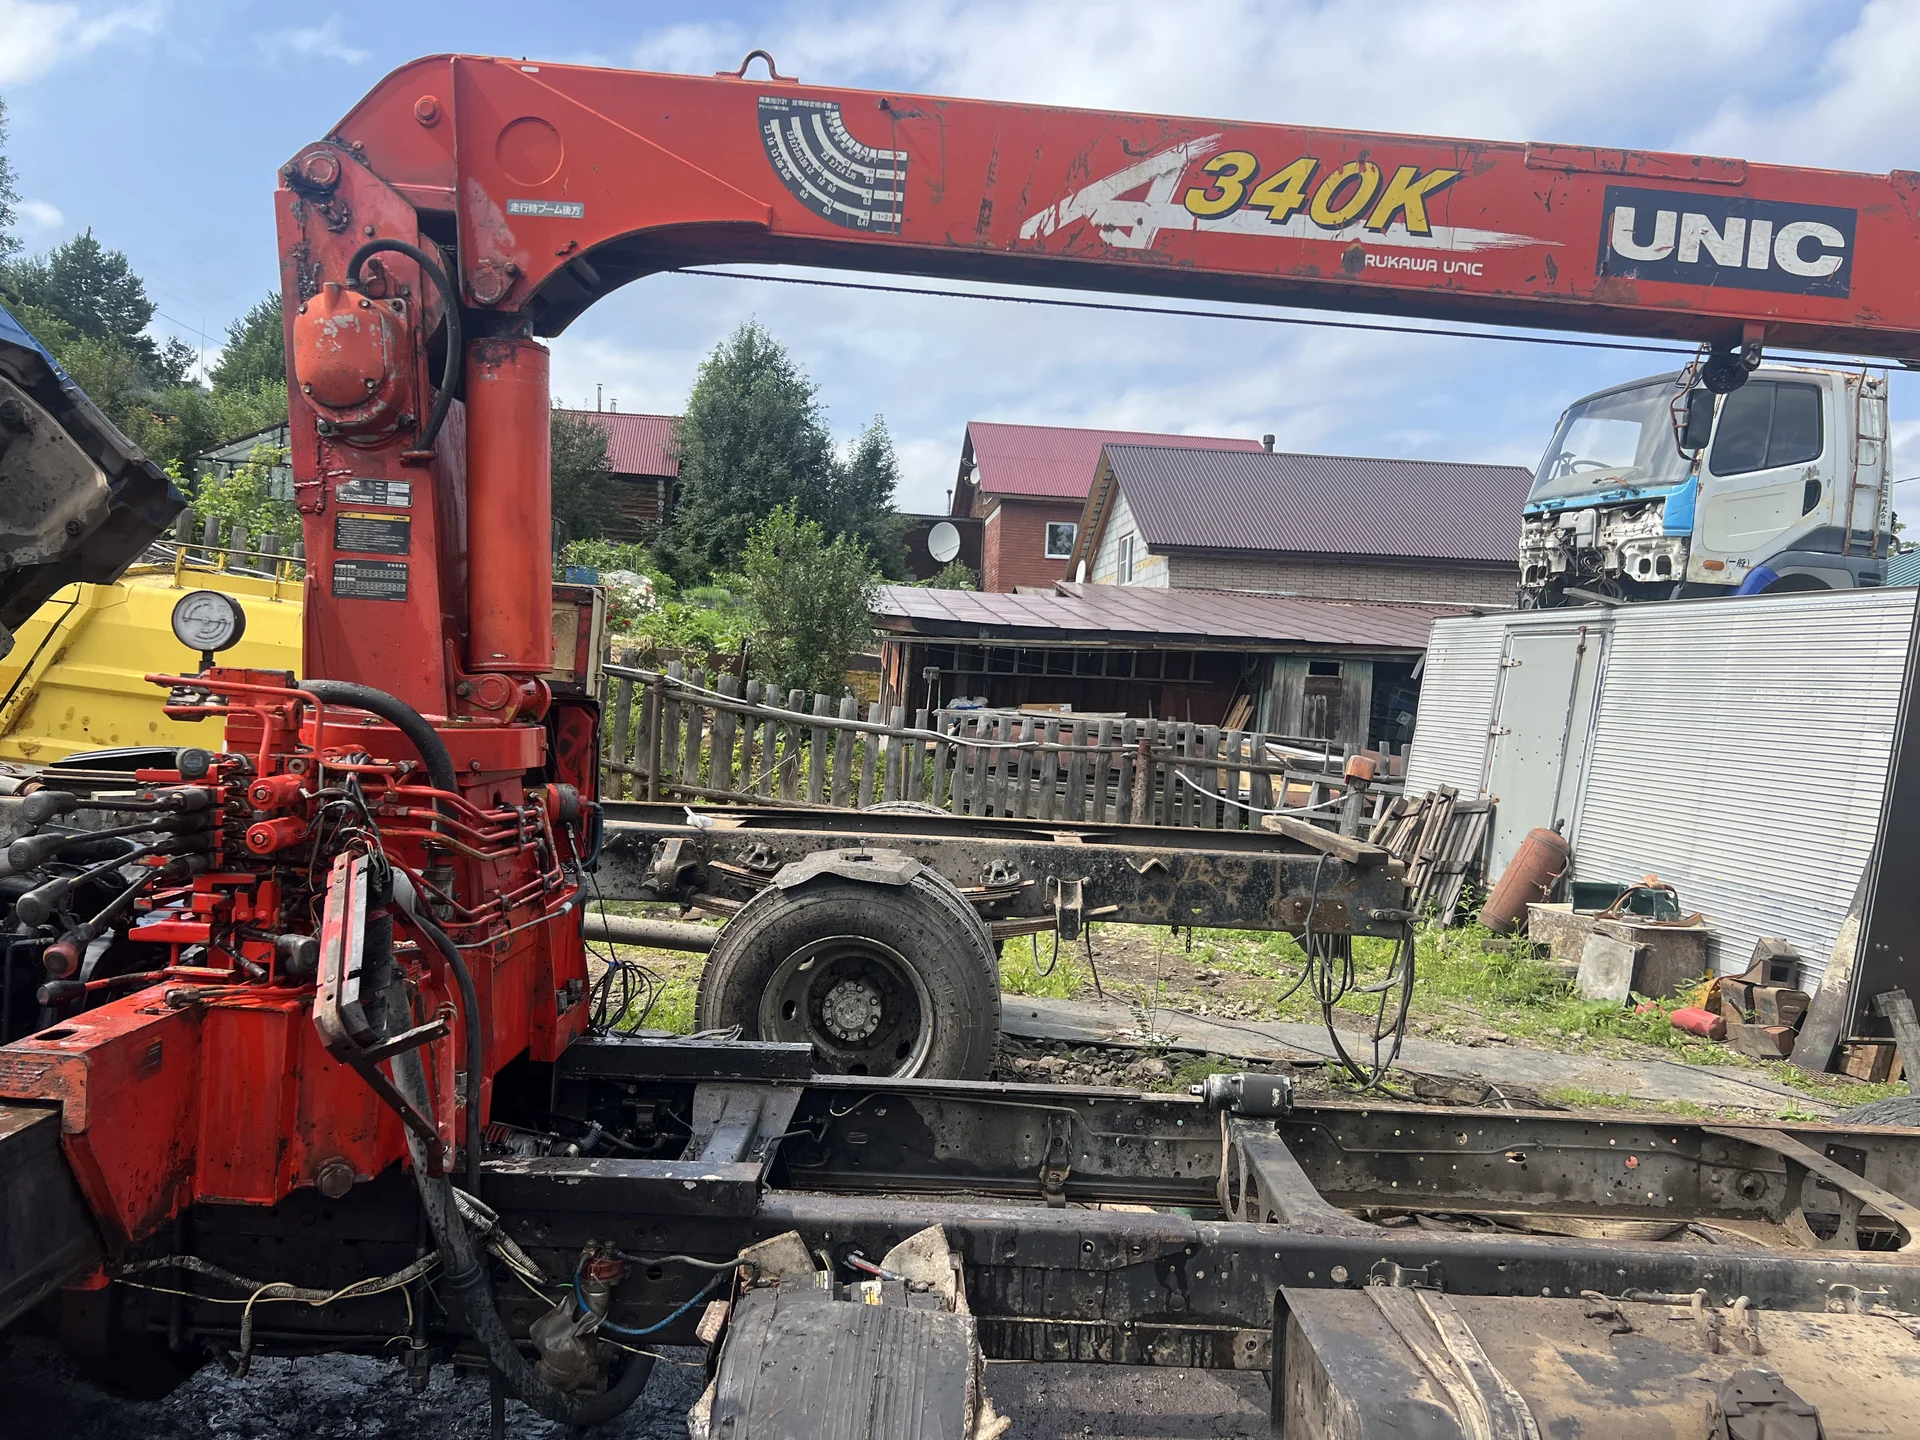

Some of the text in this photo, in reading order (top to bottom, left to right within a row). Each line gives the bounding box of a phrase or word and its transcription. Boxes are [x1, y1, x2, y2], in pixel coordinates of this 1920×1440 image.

[764, 124, 772, 134] 2.3
[766, 137, 774, 146] 1.9
[770, 149, 779, 158] 1.3
[790, 139, 798, 148] 2.7
[806, 166, 814, 175] 1.2
[828, 160, 838, 168] 2.7
[836, 166, 846, 174] 2.4
[846, 170, 857, 180] 2.15
[828, 184, 836, 194] 0.9
[1184, 150, 1469, 237] 340K
[510, 202, 581, 216] 走行時ブーム後方
[822, 206, 832, 216] 0.5
[857, 218, 869, 227] 0.47
[1611, 206, 1846, 277] UNIC
[1341, 252, 1484, 276] RUKAWA UNIC
